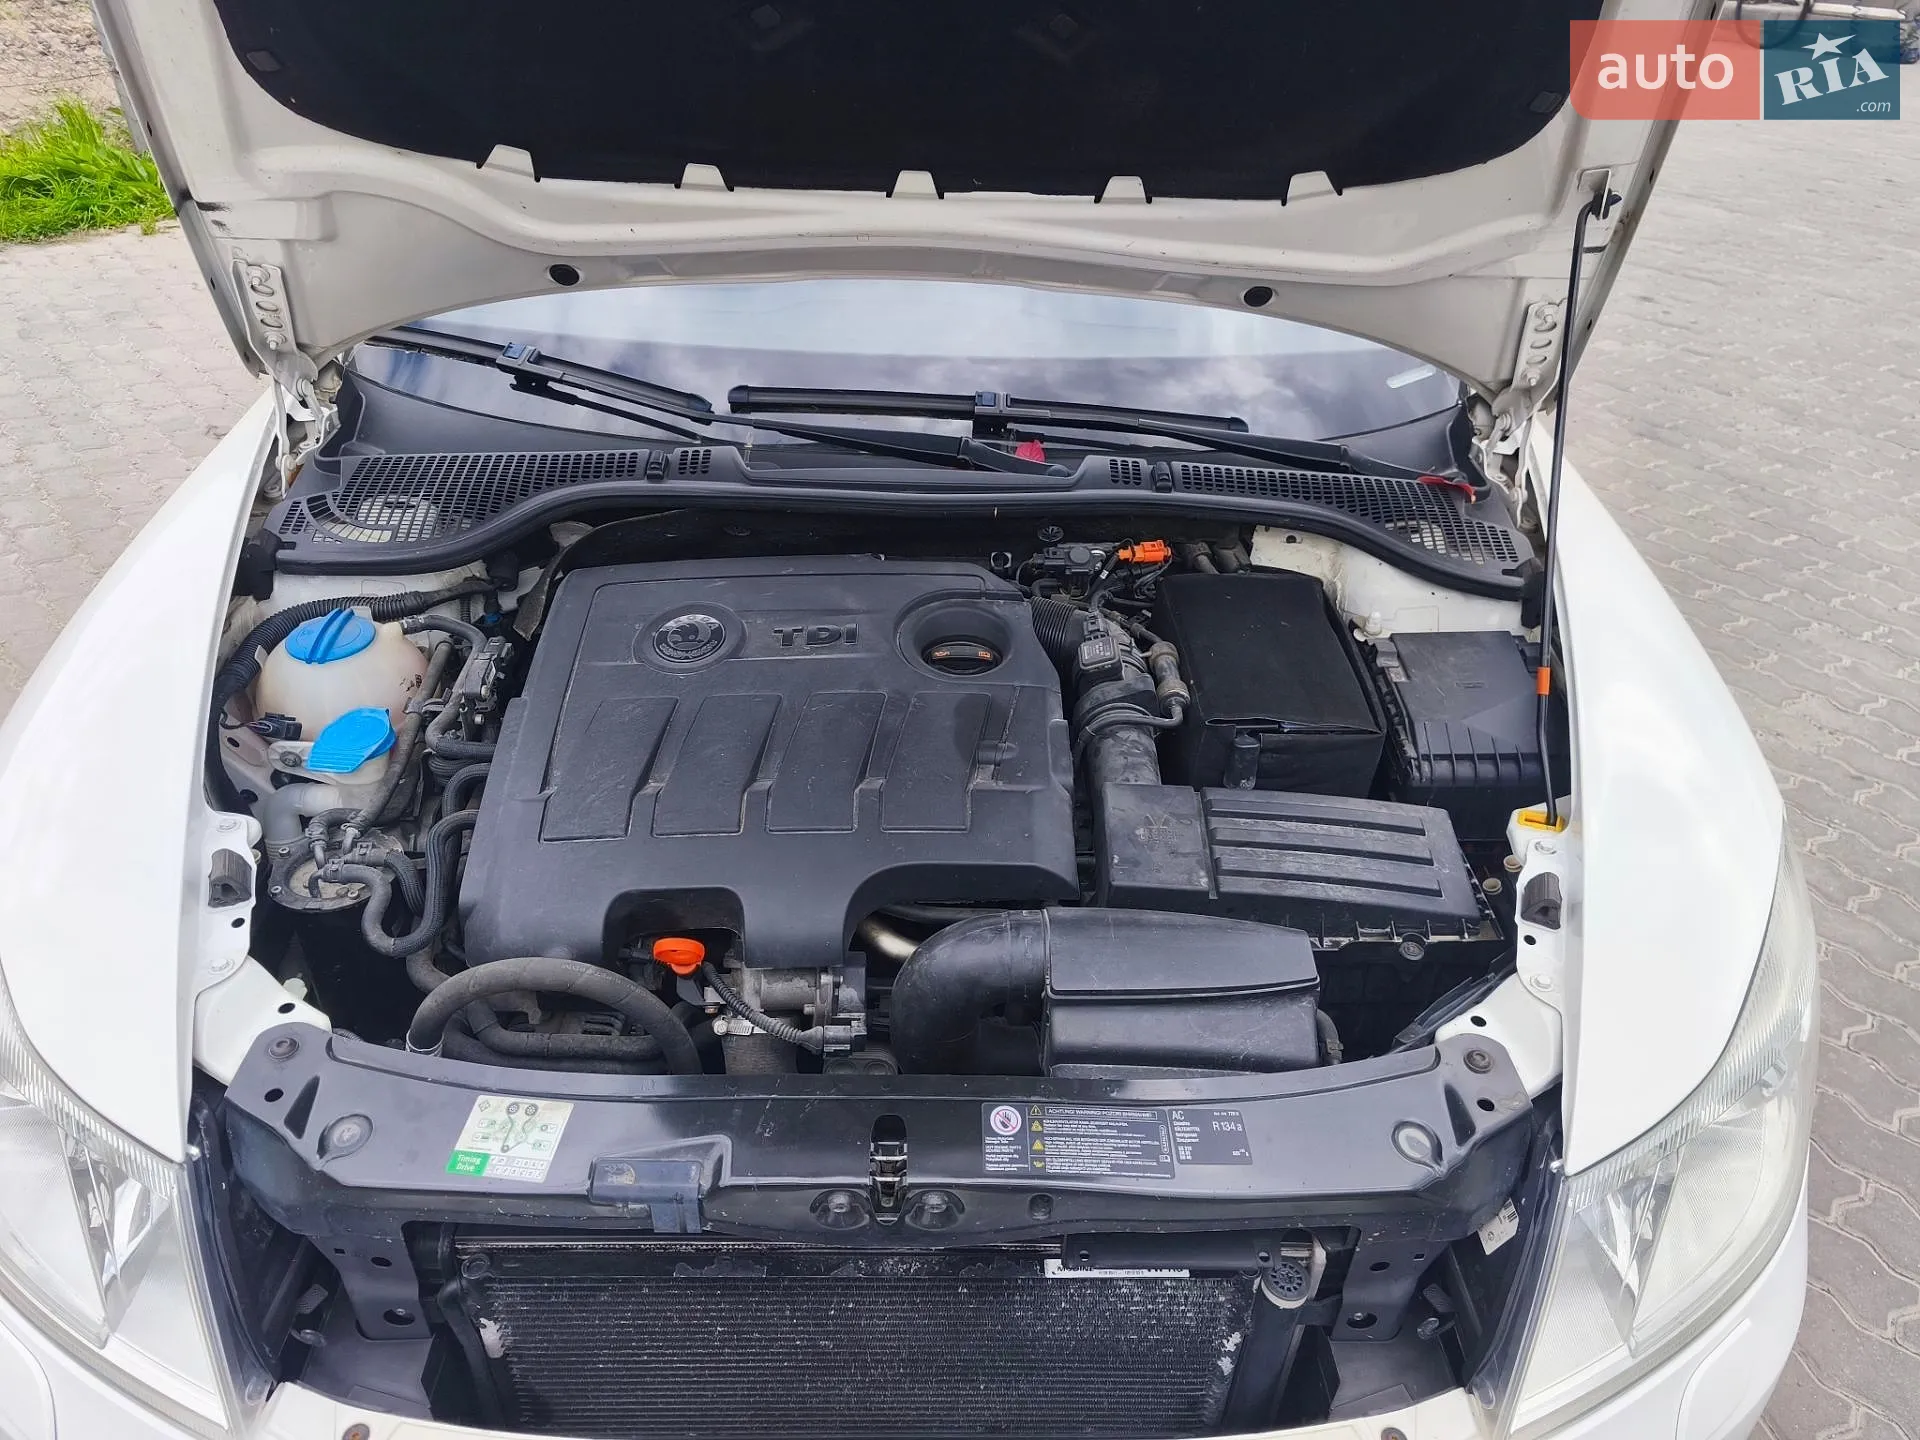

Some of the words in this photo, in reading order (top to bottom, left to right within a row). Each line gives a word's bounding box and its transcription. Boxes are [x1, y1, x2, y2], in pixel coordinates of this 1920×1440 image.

[772, 624, 859, 648] TDI
[1172, 1110, 1185, 1120] AC
[1212, 1121, 1220, 1131] R
[457, 1154, 482, 1165] Timing
[456, 1163, 475, 1172] Drive
